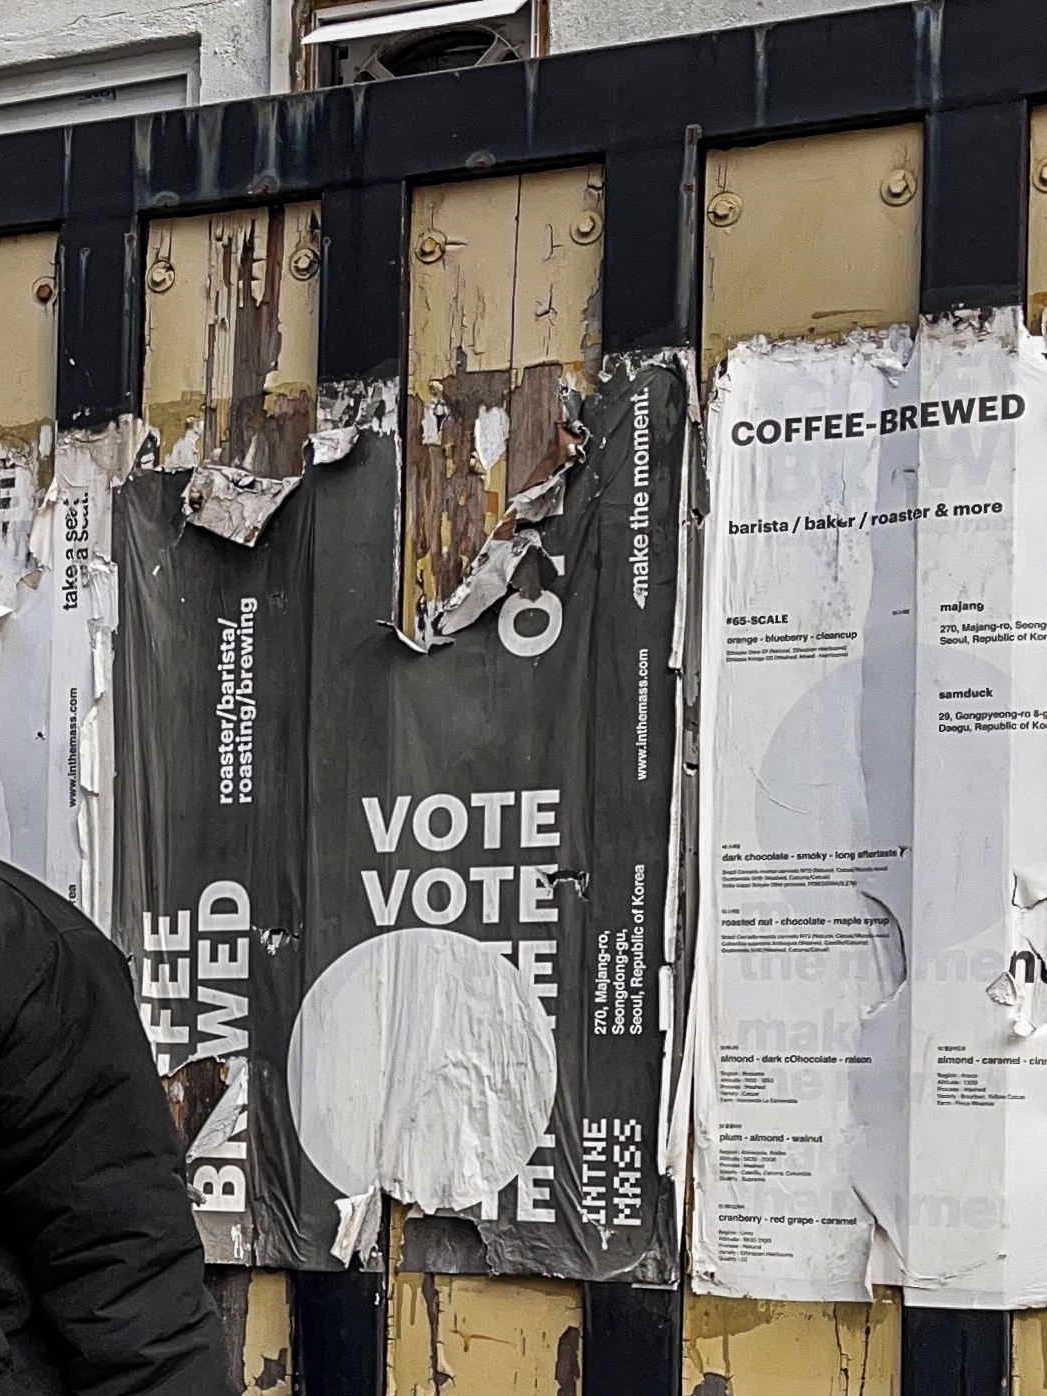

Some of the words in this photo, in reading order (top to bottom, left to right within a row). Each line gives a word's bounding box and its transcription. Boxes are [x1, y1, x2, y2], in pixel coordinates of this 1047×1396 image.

[630, 387, 649, 489] moment.
[731, 393, 1026, 447] COFFEE-BREWED
[630, 491, 650, 532] the
[728, 518, 789, 535] barista
[871, 504, 931, 527] roaster
[935, 503, 949, 517] &
[953, 501, 1003, 516] more
[629, 535, 650, 597] make
[940, 601, 985, 612] majang
[727, 635, 758, 645] orange
[972, 633, 1014, 644] Republic
[1017, 632, 1027, 641] of
[216, 617, 238, 804] roaster/barista/
[235, 597, 258, 804] roasting/brewing
[939, 687, 993, 700] samduck
[637, 649, 649, 781] www.inthemass.com
[975, 721, 1017, 733] Republic
[1019, 721, 1030, 730] of
[67, 687, 79, 808] www.inthemass.com
[361, 789, 561, 854] VOTE
[722, 852, 743, 862] dark
[744, 852, 789, 862] chocolate
[796, 851, 827, 862] smoky
[835, 851, 856, 861] long
[360, 863, 559, 926] VOTE
[631, 864, 645, 905] Korea
[631, 908, 645, 924] of
[721, 917, 756, 927] roasted
[780, 917, 826, 926] chocolate
[833, 916, 862, 927] maple
[863, 917, 890, 927] syrup
[595, 930, 611, 1003] Majang-ro,
[630, 926, 647, 988] Republic
[611, 929, 629, 1035] Seongdong-gu,
[594, 1006, 610, 1035] 270,
[630, 990, 646, 1035] Seoul,
[192, 879, 251, 1213] BWED
[720, 1054, 755, 1064] almond
[761, 1054, 782, 1064] dark
[937, 1055, 974, 1065] almond
[981, 1056, 1021, 1065] caramel
[719, 1133, 743, 1143] plum
[749, 1133, 784, 1143] almond
[612, 1118, 642, 1226] MASS
[718, 1213, 762, 1224] cranberry
[769, 1215, 785, 1224] red
[787, 1217, 814, 1226] grape
[821, 1217, 857, 1225] caramel
